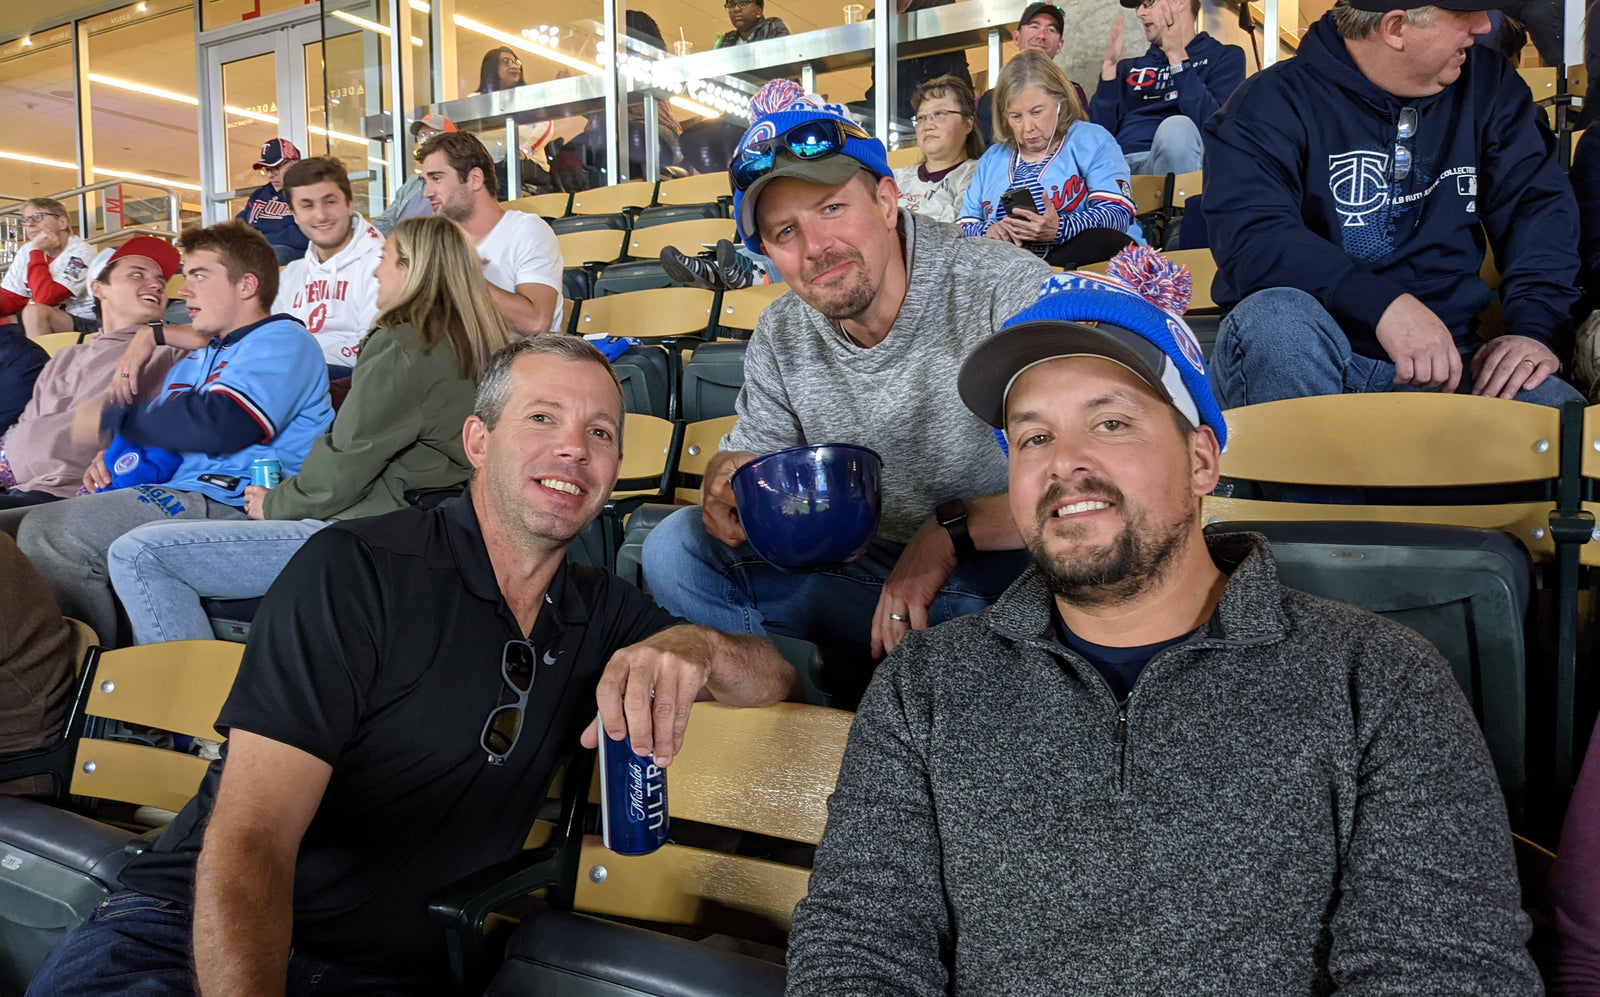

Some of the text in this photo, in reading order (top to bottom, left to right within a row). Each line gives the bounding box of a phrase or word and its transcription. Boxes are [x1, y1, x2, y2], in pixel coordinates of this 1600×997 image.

[140, 485, 186, 517] AGAN
[628, 762, 646, 821] Michelob
[646, 762, 664, 830] ULTR
